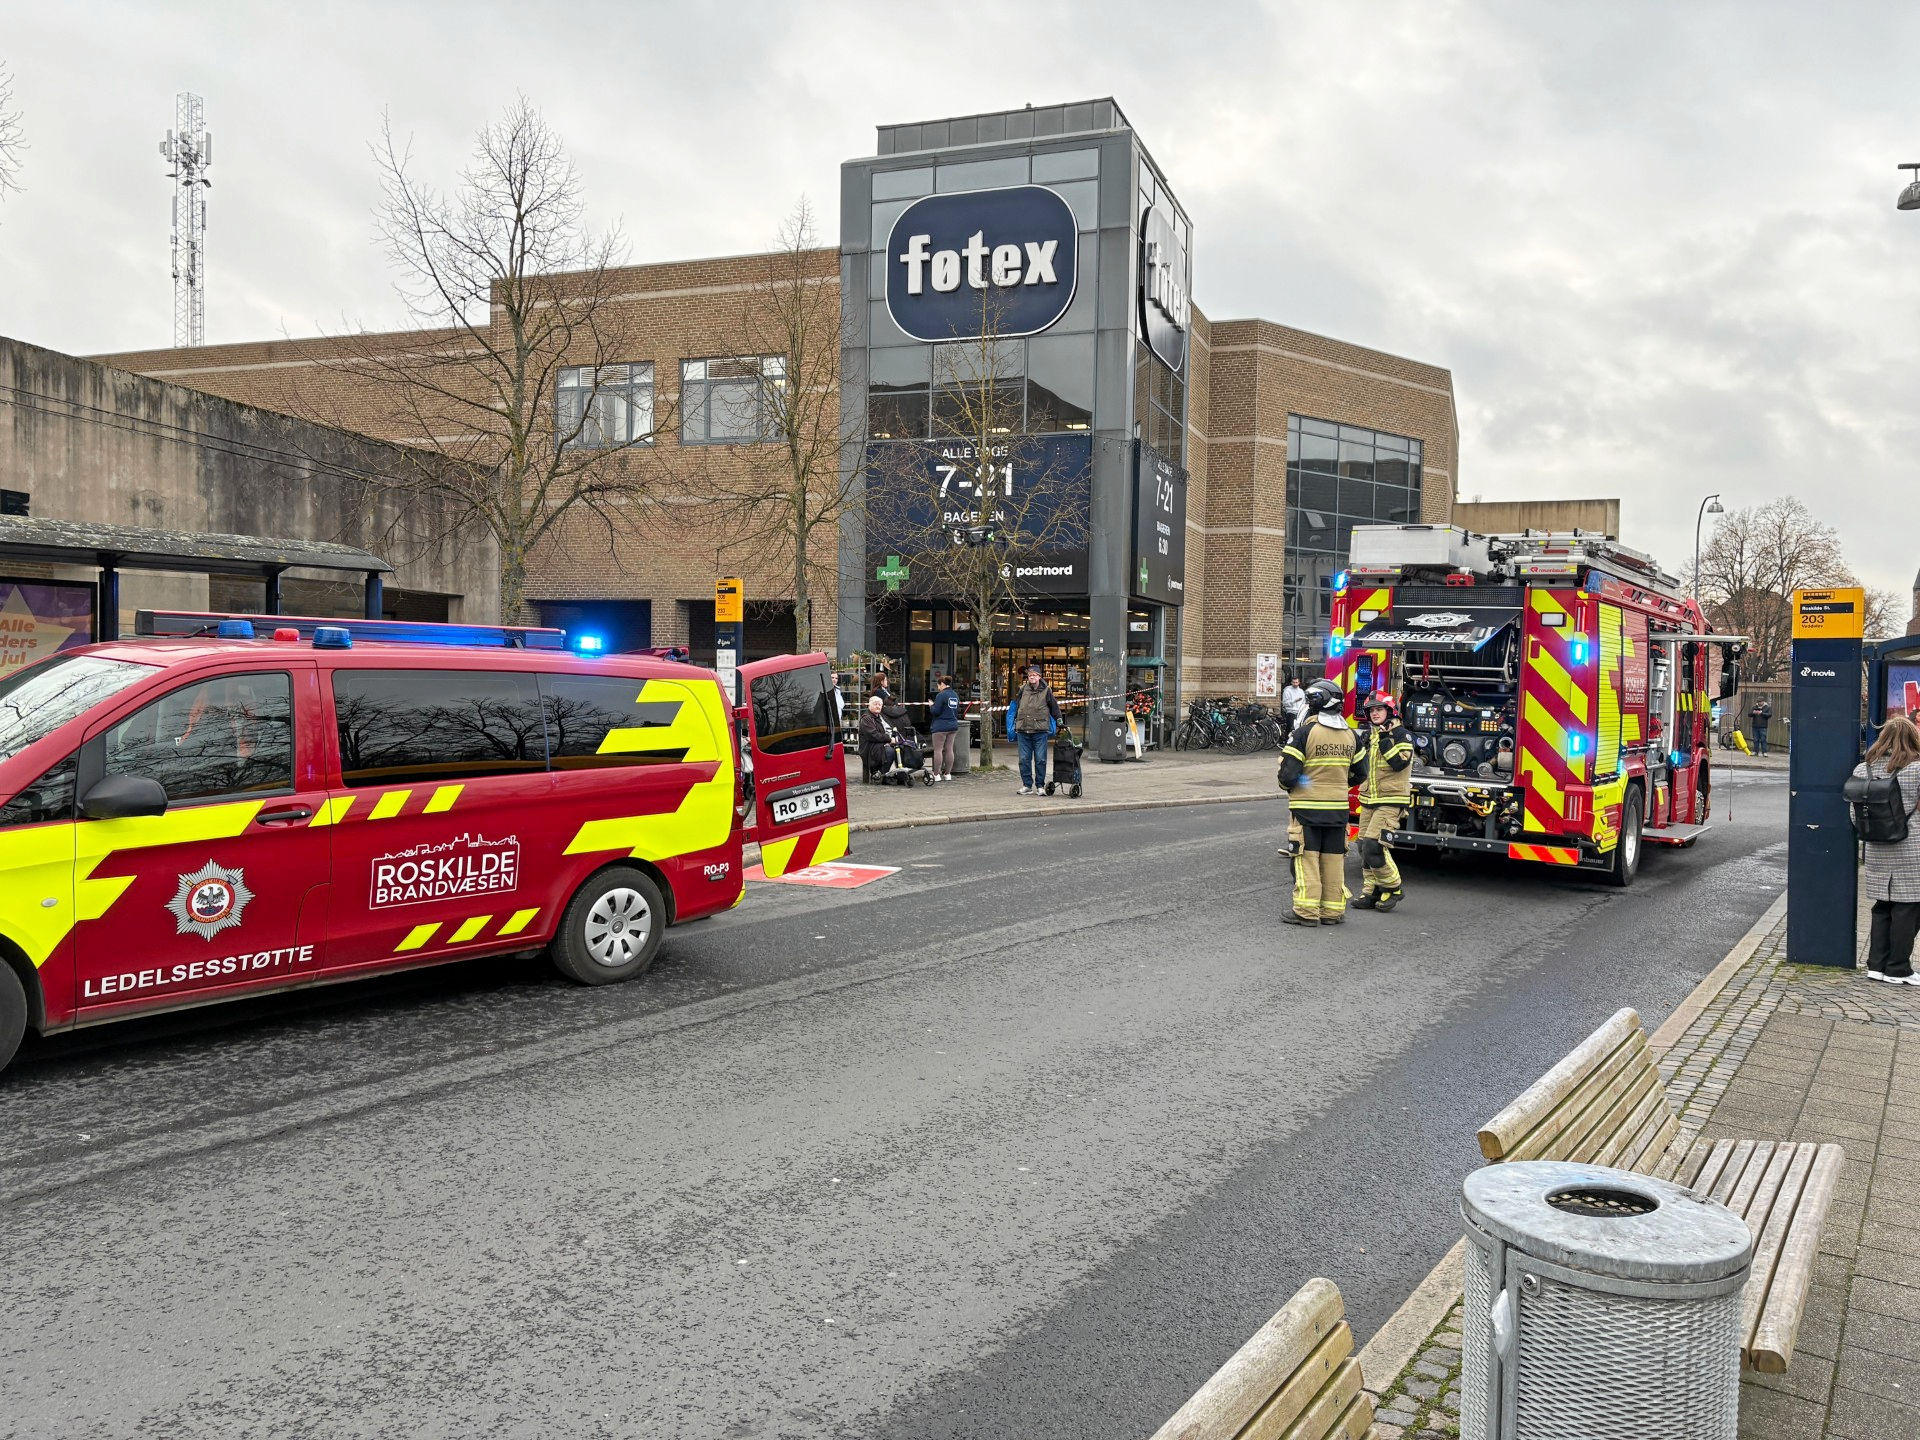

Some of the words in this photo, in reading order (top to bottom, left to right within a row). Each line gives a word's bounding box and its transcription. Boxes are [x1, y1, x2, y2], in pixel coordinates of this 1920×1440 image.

[900, 229, 1058, 296] føtex
[942, 447, 971, 459] ALLE
[975, 445, 1008, 458] DGE
[936, 462, 1013, 498] 7-21
[1156, 474, 1173, 514] 7-21
[943, 510, 1004, 523] BAGEEN
[1016, 564, 1072, 578] postnord
[0, 619, 35, 633] Alle
[1801, 614, 1825, 624] 203
[0, 634, 38, 648] ders
[0, 650, 26, 668] jul
[1811, 669, 1836, 677] movia
[778, 801, 798, 817] RO
[814, 792, 831, 807] P3
[377, 850, 516, 888] ROSKILDE
[703, 862, 730, 876] RO-P3
[375, 872, 514, 904] BRANDVÆSEN
[84, 944, 314, 998] LEDELSESSTØTTE
